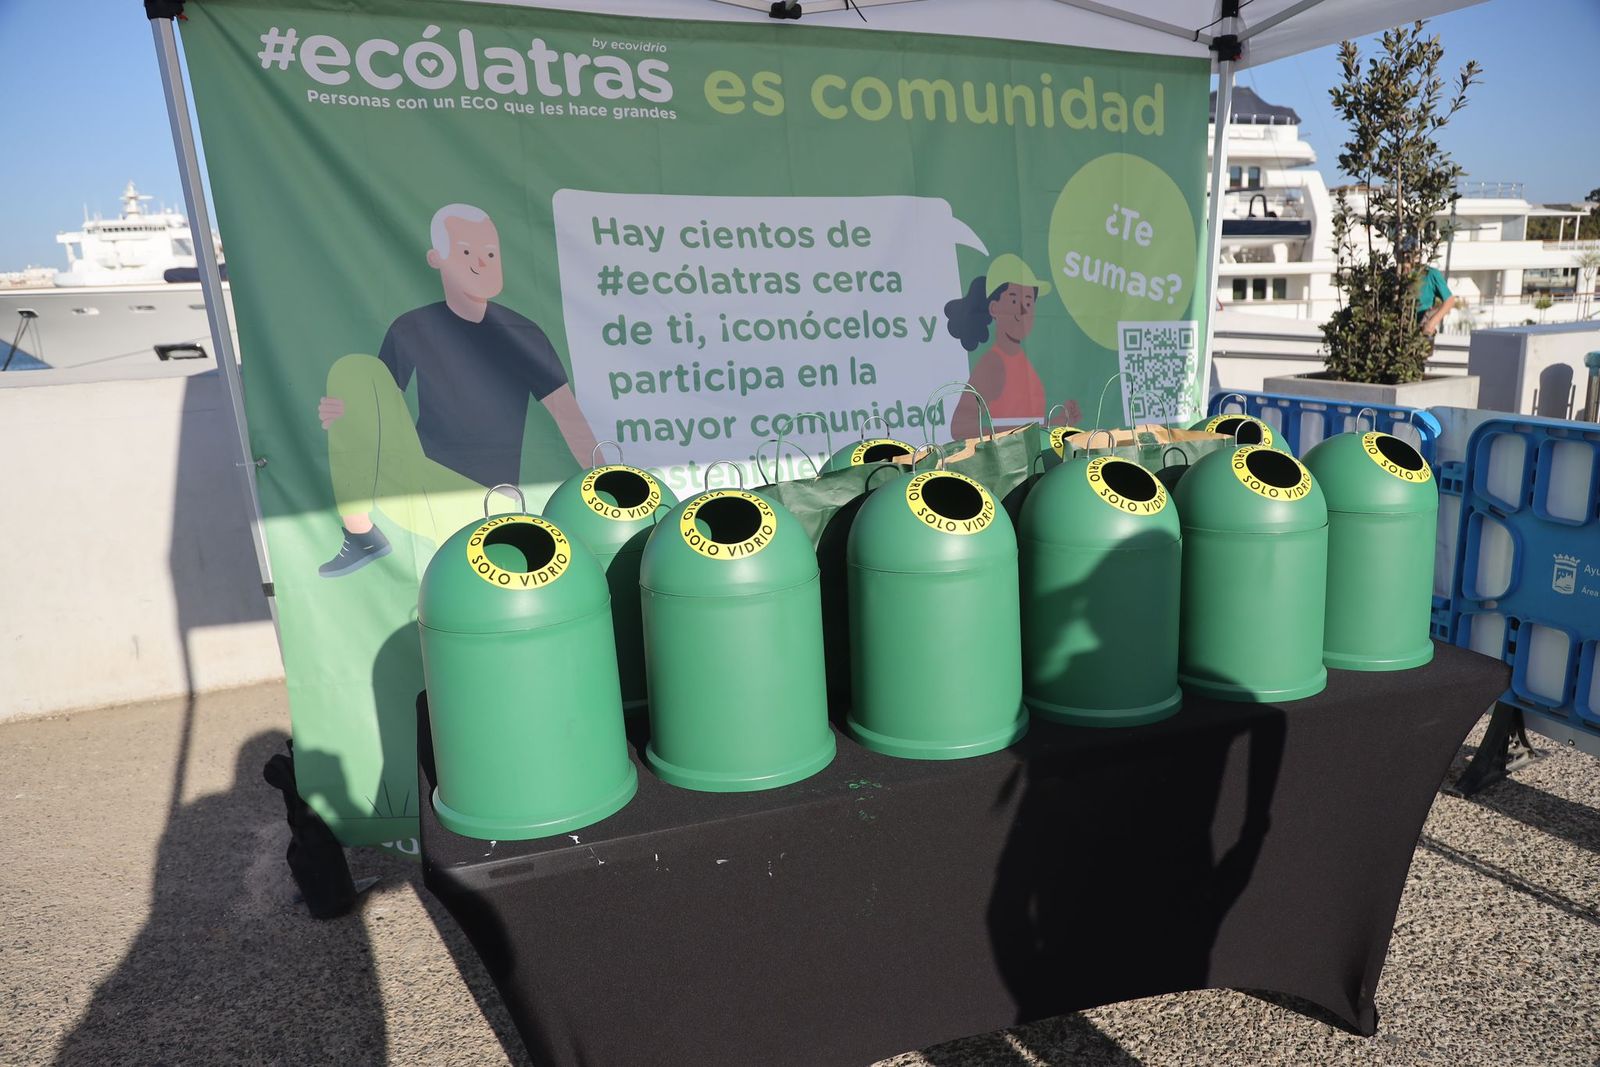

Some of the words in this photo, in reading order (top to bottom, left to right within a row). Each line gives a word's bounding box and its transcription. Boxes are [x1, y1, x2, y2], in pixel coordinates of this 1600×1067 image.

[592, 37, 607, 49] by
[611, 40, 667, 53] ecovidrio
[257, 24, 674, 103] #ecólatras
[307, 89, 391, 108] Personas
[396, 97, 428, 110] con
[433, 97, 455, 109] un
[460, 95, 498, 110] ECO
[503, 101, 535, 115] que
[540, 101, 563, 115] les
[569, 102, 608, 117] hace
[612, 106, 677, 120] grandes
[703, 69, 785, 117] es
[810, 72, 1165, 137] comunidad
[591, 216, 665, 253] Hay
[679, 219, 815, 249] cientos
[826, 219, 872, 249] de
[1105, 203, 1153, 247] ¿Te
[597, 264, 801, 296] #ecólatras
[812, 270, 903, 293] cerca
[1062, 250, 1183, 305] sumas?
[601, 314, 653, 346] de
[666, 312, 706, 349] ti,
[718, 309, 908, 343] ¡conócelos
[918, 315, 937, 343] y
[608, 360, 785, 400] participa
[797, 362, 838, 388] en
[849, 356, 877, 385] la
[615, 415, 737, 446] mayor
[750, 398, 946, 438] comunidad
[1380, 459, 1414, 480] SOLO
[909, 472, 938, 501] VIDRIO
[1100, 488, 1138, 512] SOLO
[1142, 485, 1165, 512] VIDRIO
[1243, 475, 1279, 498] SOLO
[1284, 473, 1310, 499] VIDRIO
[588, 497, 621, 518] SOLO
[627, 491, 659, 518] VIDRIO
[683, 491, 725, 520] VIDRIO
[741, 493, 773, 517] SOLO
[917, 507, 957, 532] SOLO
[962, 500, 993, 532] VIDRIO
[470, 516, 516, 546] VIDRIO
[532, 518, 567, 545] SOLO
[684, 528, 719, 556] SOLO
[727, 525, 773, 557] VIDRIO
[472, 555, 511, 585] SOLO
[519, 553, 567, 587] VIDRIO
